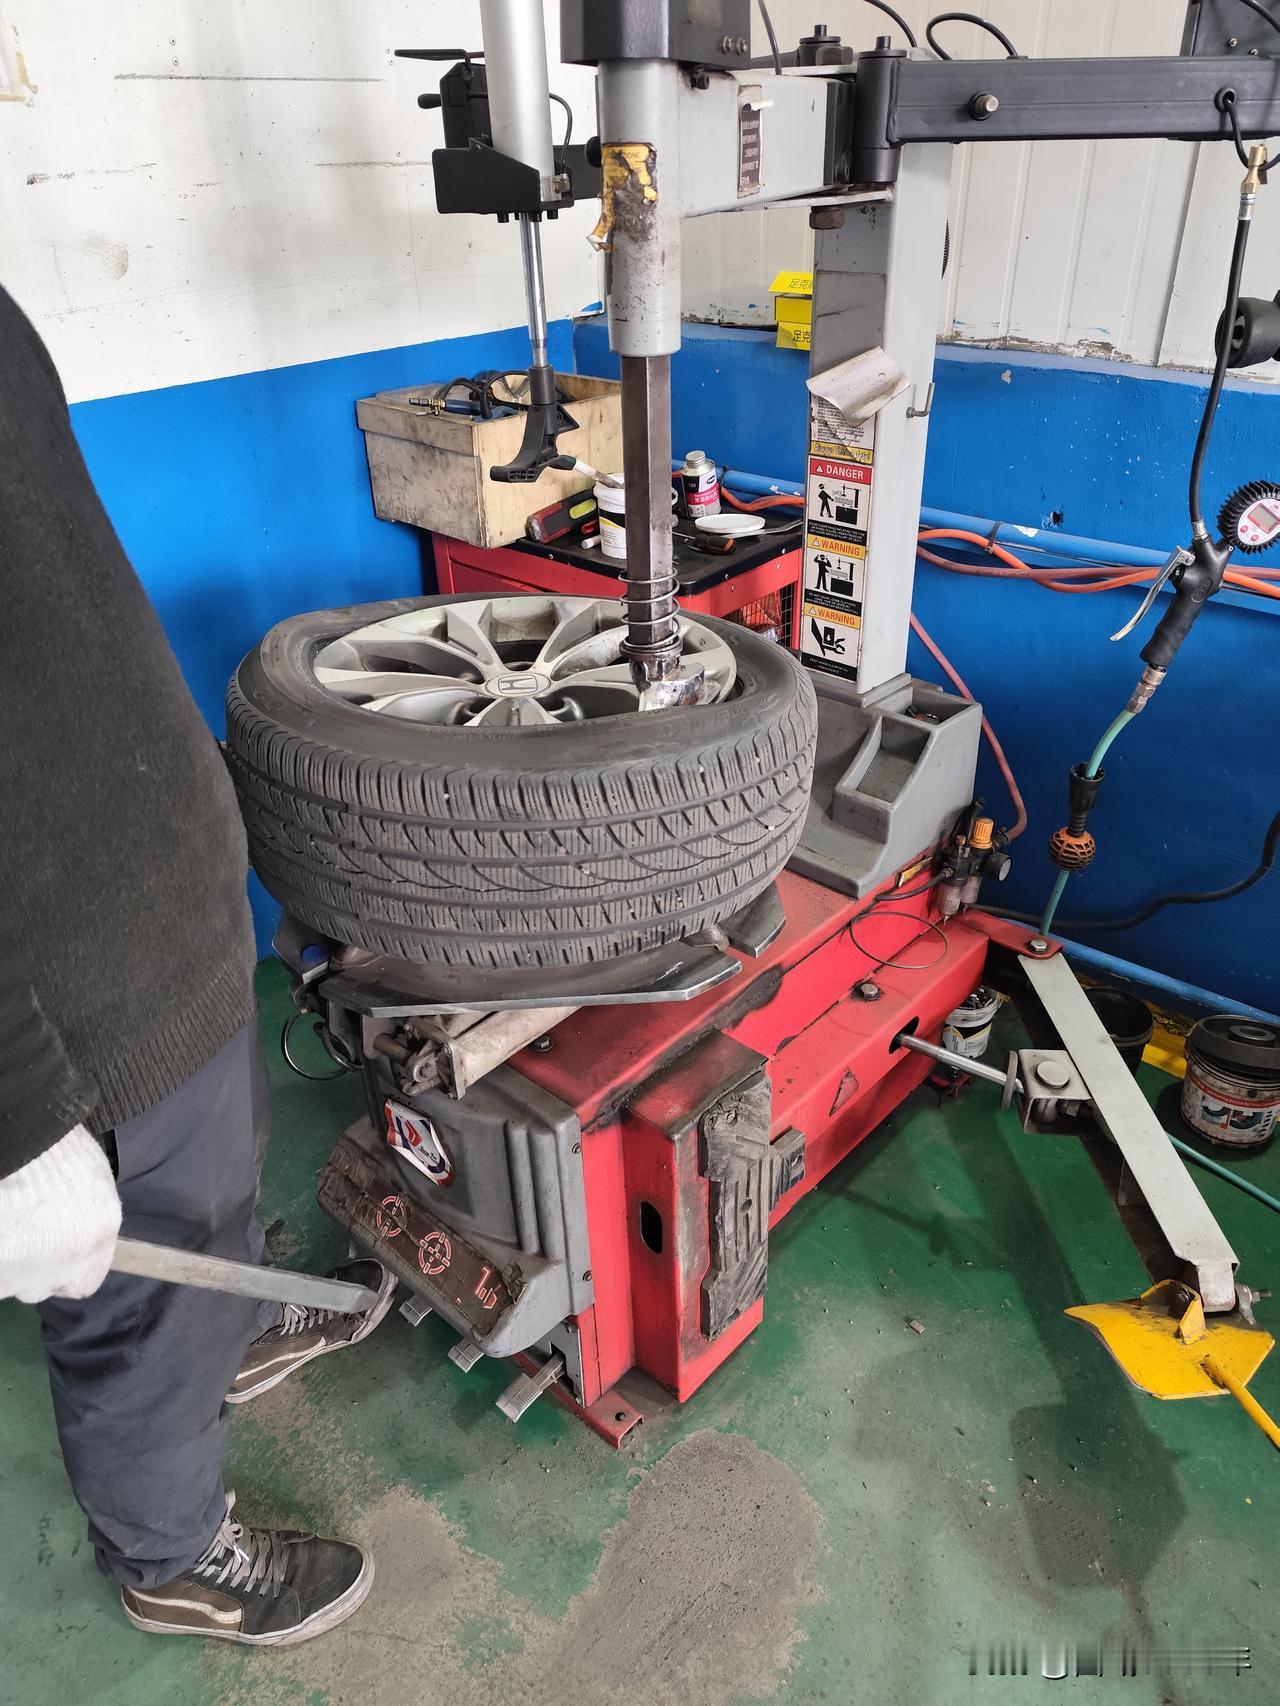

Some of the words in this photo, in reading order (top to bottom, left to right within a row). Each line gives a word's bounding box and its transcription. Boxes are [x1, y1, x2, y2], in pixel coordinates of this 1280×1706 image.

[788, 279, 813, 289] 足克
[826, 465, 863, 480] DANGER
[821, 540, 860, 556] WARNING
[818, 608, 855, 625] WARNING
